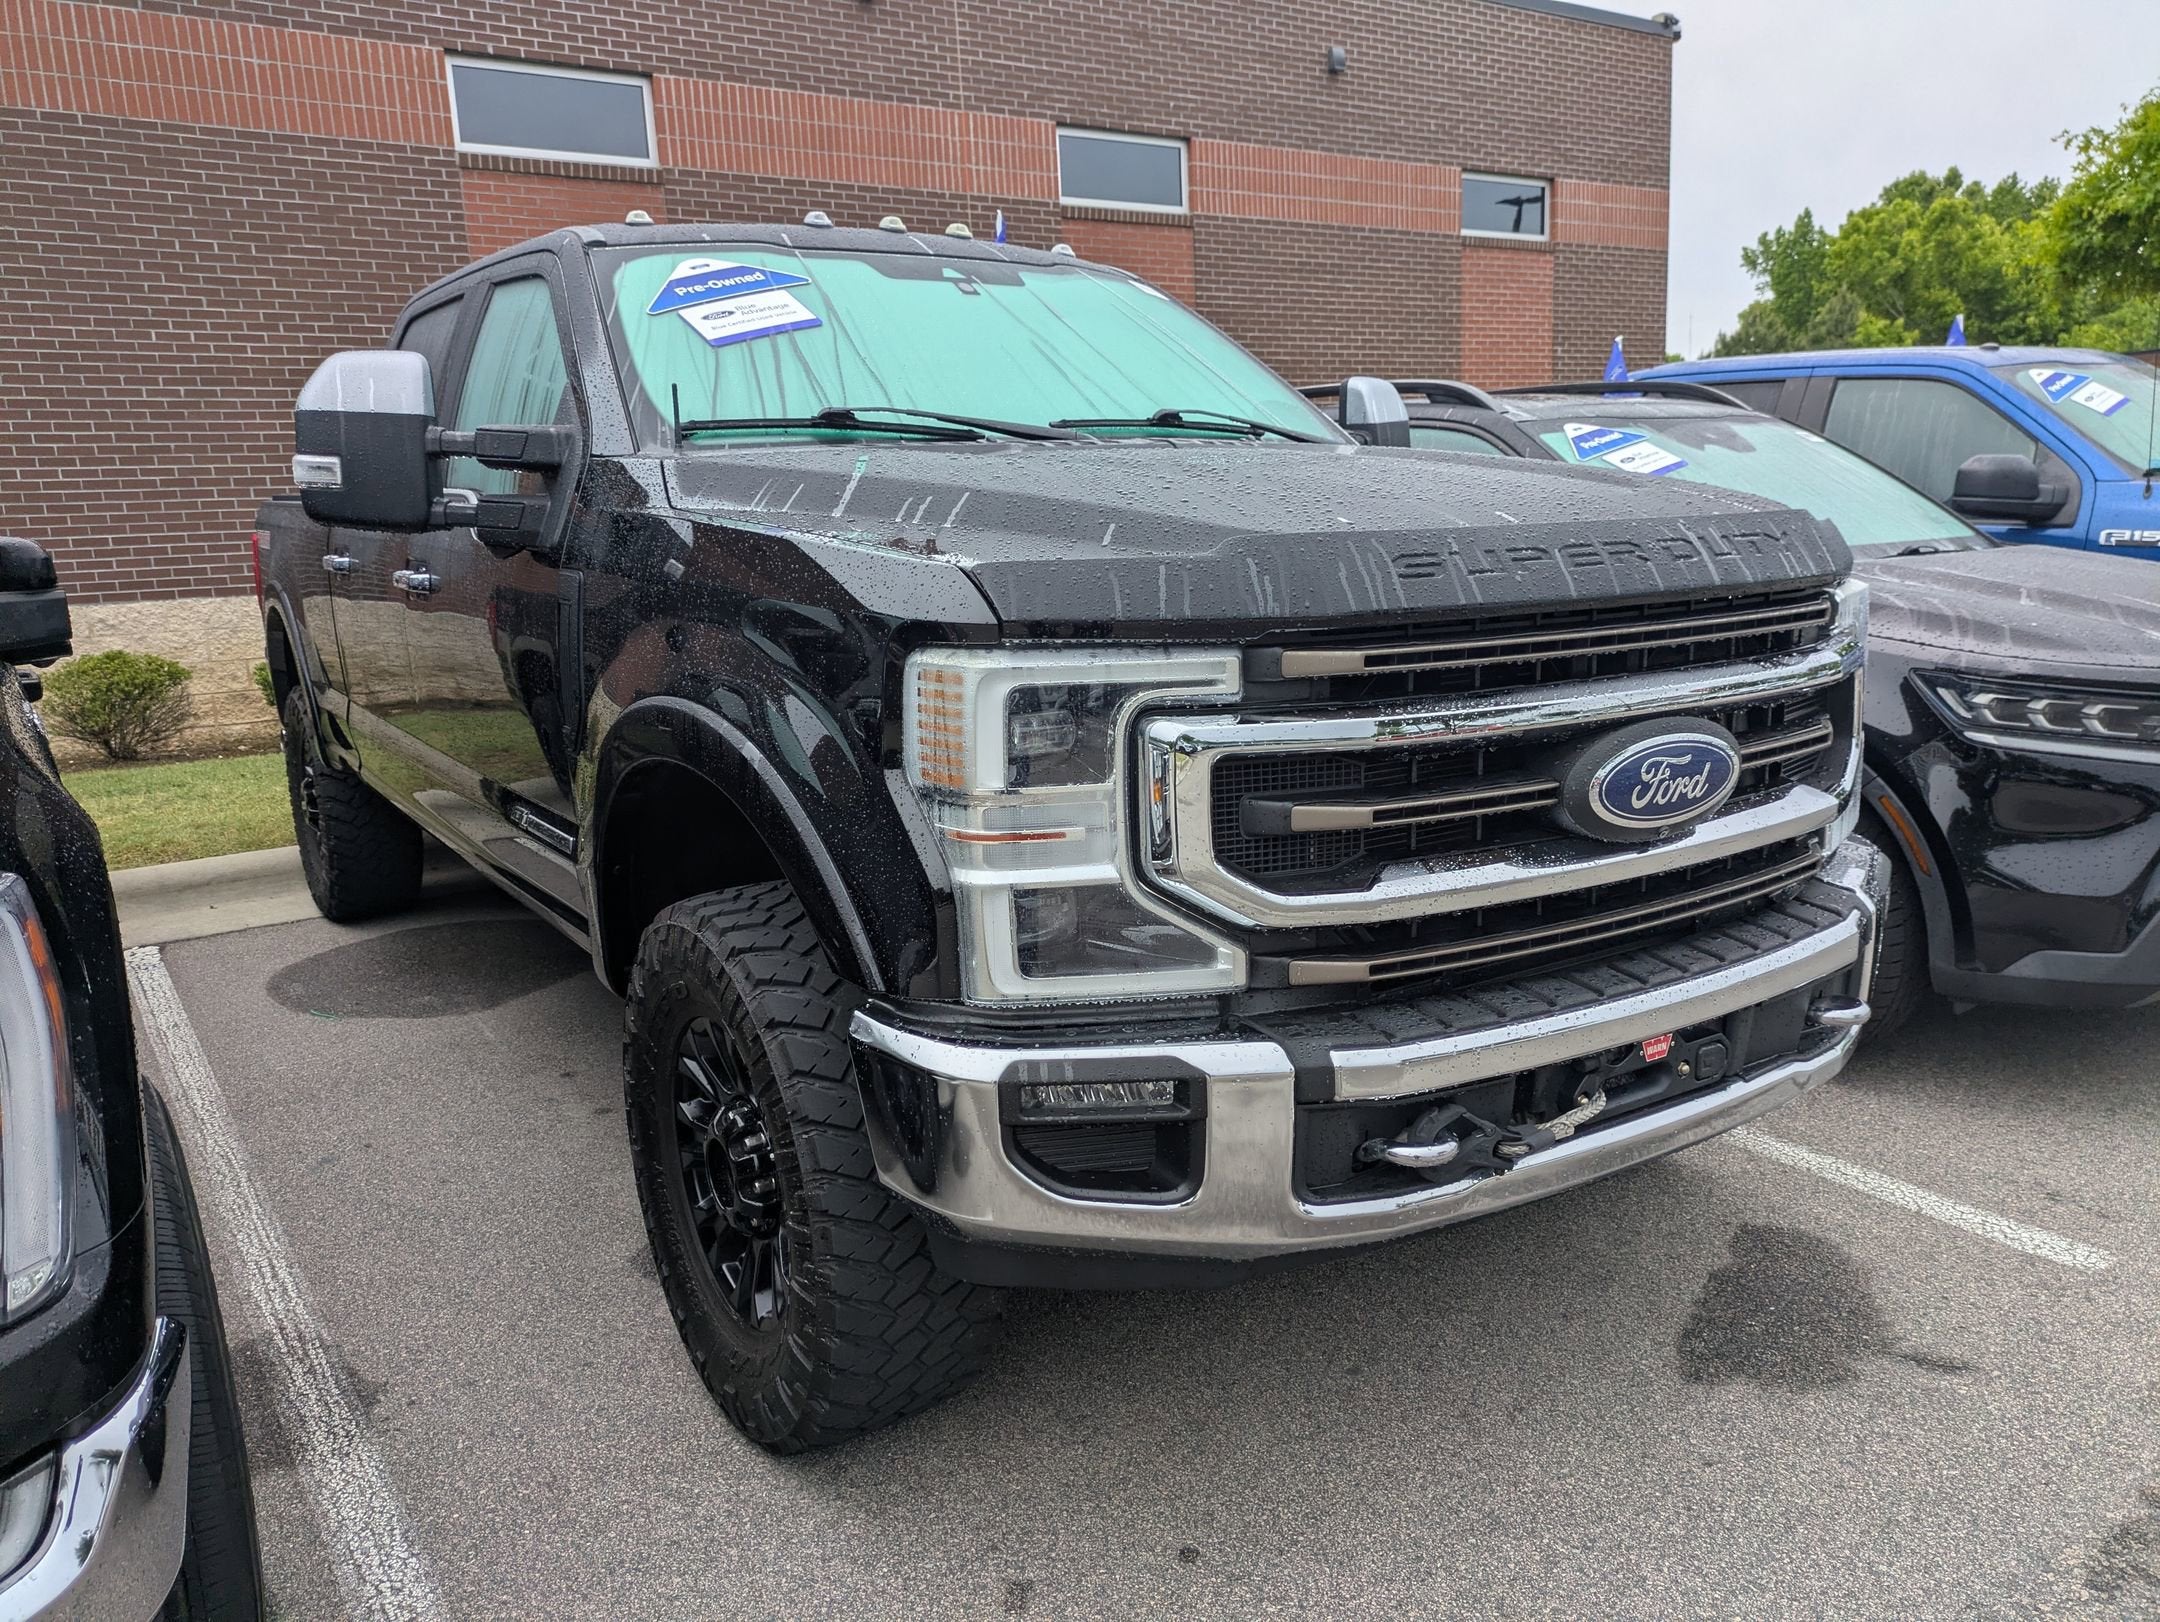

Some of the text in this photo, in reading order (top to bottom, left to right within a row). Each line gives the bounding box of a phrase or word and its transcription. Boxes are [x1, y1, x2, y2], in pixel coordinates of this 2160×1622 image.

[674, 271, 766, 296] Pre-Owned
[734, 303, 757, 311] Blue
[741, 303, 790, 316] Advantage
[1631, 753, 1711, 809] Ford
[1646, 1041, 1667, 1056] WARN
